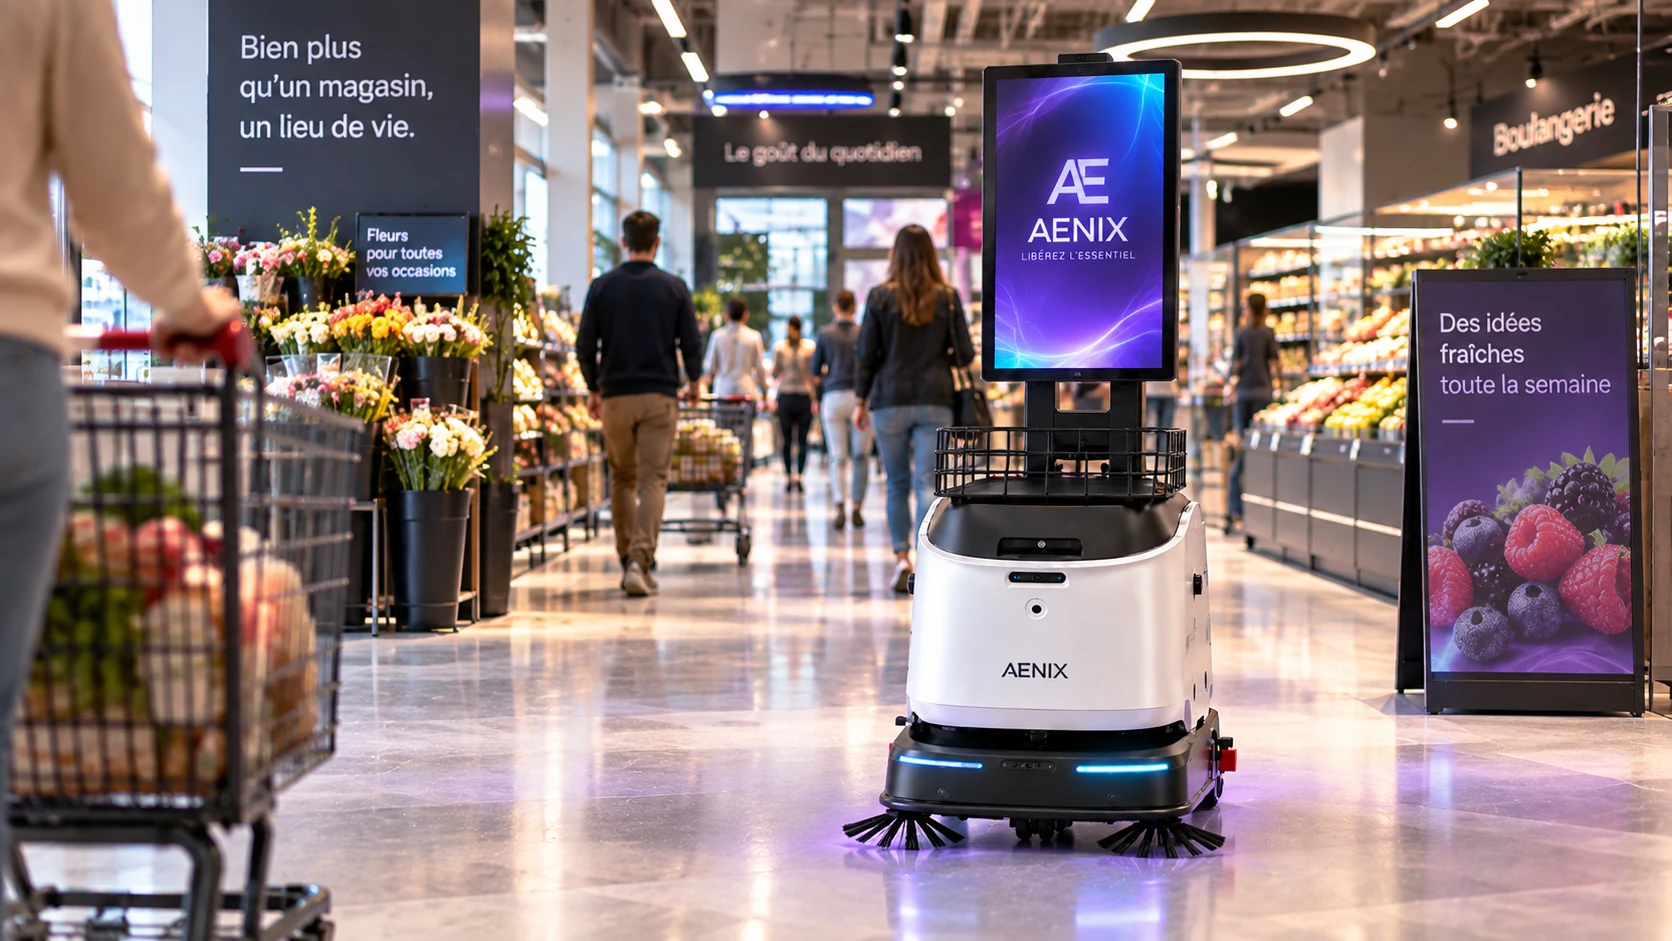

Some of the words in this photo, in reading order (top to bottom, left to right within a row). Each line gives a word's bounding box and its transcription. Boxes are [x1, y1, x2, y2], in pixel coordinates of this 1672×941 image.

[241, 34, 299, 60] Bien
[307, 33, 362, 65] plus
[319, 72, 434, 104] magasin,
[240, 120, 272, 139] un
[279, 113, 324, 139] lieu
[331, 113, 365, 139] de
[371, 113, 415, 139] vie.
[1493, 91, 1615, 157] Boulangerie
[724, 142, 750, 163] Le
[752, 141, 799, 167] goût
[800, 141, 828, 163] du
[829, 141, 923, 167] quotidien
[1046, 158, 1109, 205] AE
[367, 228, 409, 242] Fleurs
[1027, 216, 1128, 243] AENIX
[367, 248, 399, 263] pour
[400, 246, 443, 260] toutes
[1021, 249, 1065, 261] LIBÉREZ
[366, 266, 388, 278] vos
[391, 264, 456, 278] occasions
[1440, 312, 1481, 333] Des
[1486, 311, 1542, 333] idées
[1440, 342, 1525, 364] fraîches
[1440, 374, 1496, 394] toute
[1501, 373, 1519, 394] la
[1525, 374, 1611, 394] semaine
[1001, 662, 1069, 679] AENIX
